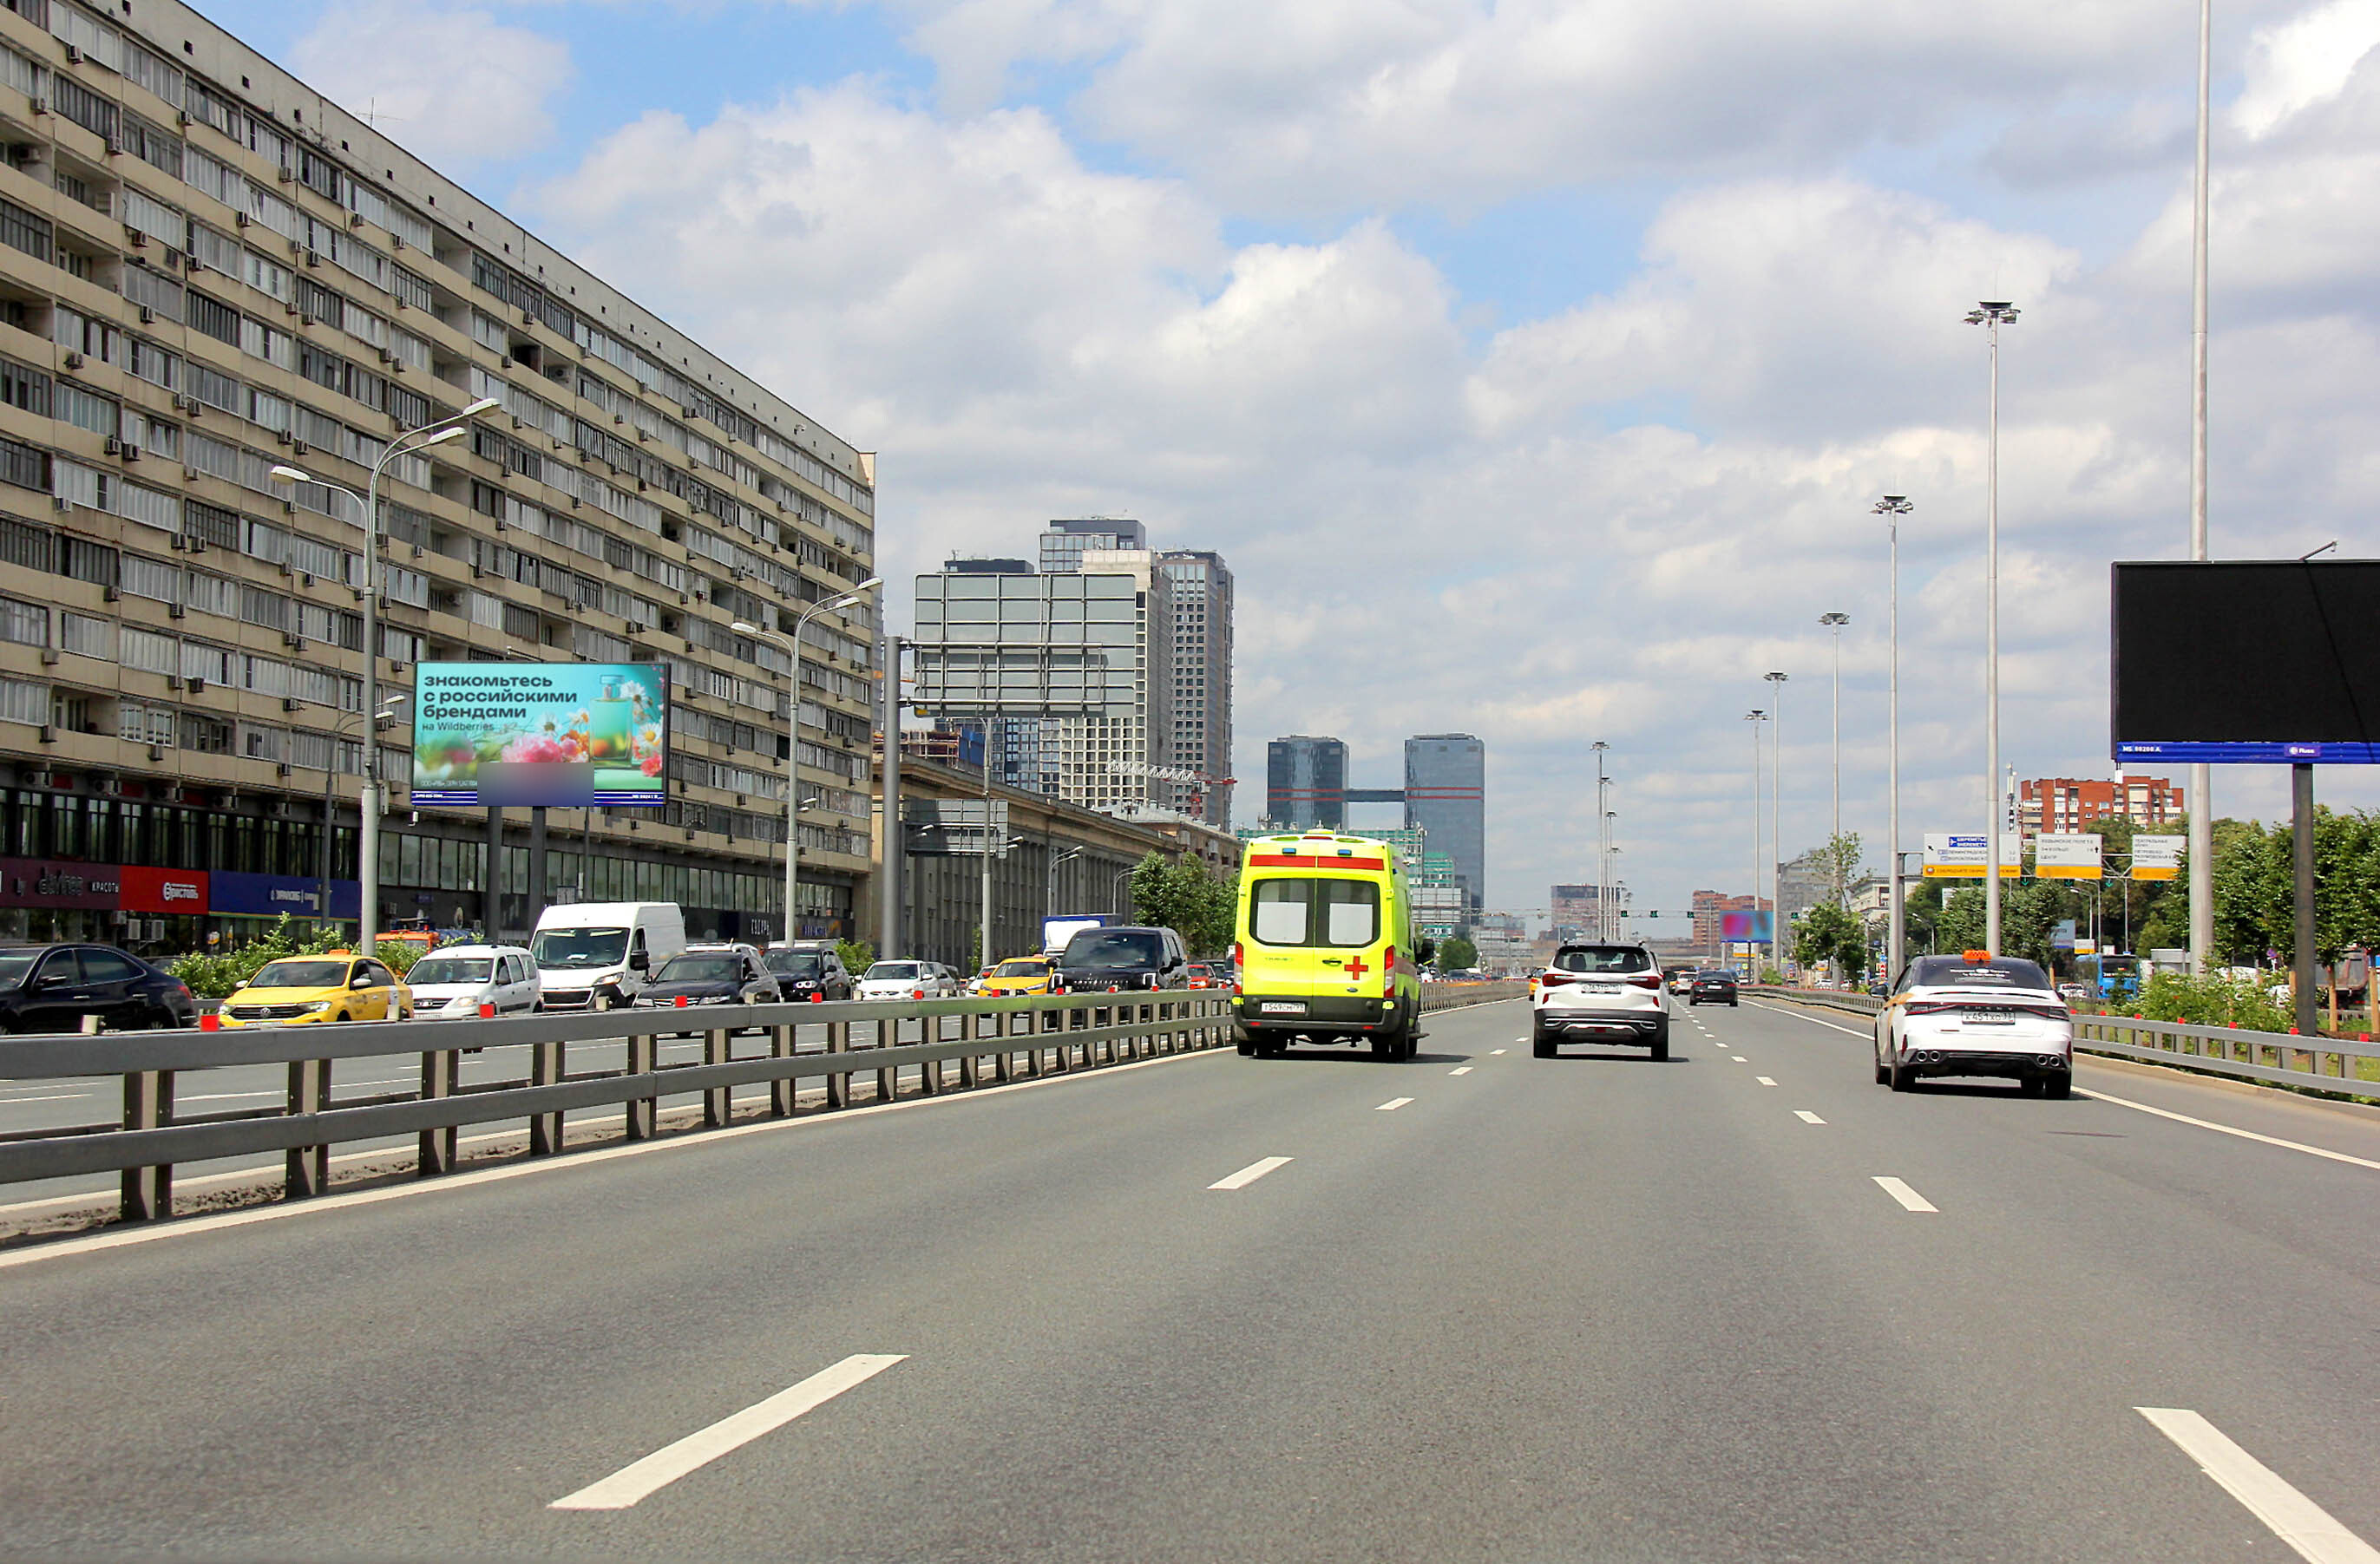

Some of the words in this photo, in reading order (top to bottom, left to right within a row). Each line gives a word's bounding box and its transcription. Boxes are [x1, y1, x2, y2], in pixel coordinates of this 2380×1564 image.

[424, 677, 553, 686] знакомьтесь
[423, 692, 435, 702] с
[440, 689, 577, 704] российскими
[423, 705, 526, 720] брендами
[437, 722, 494, 730] Wildberries
